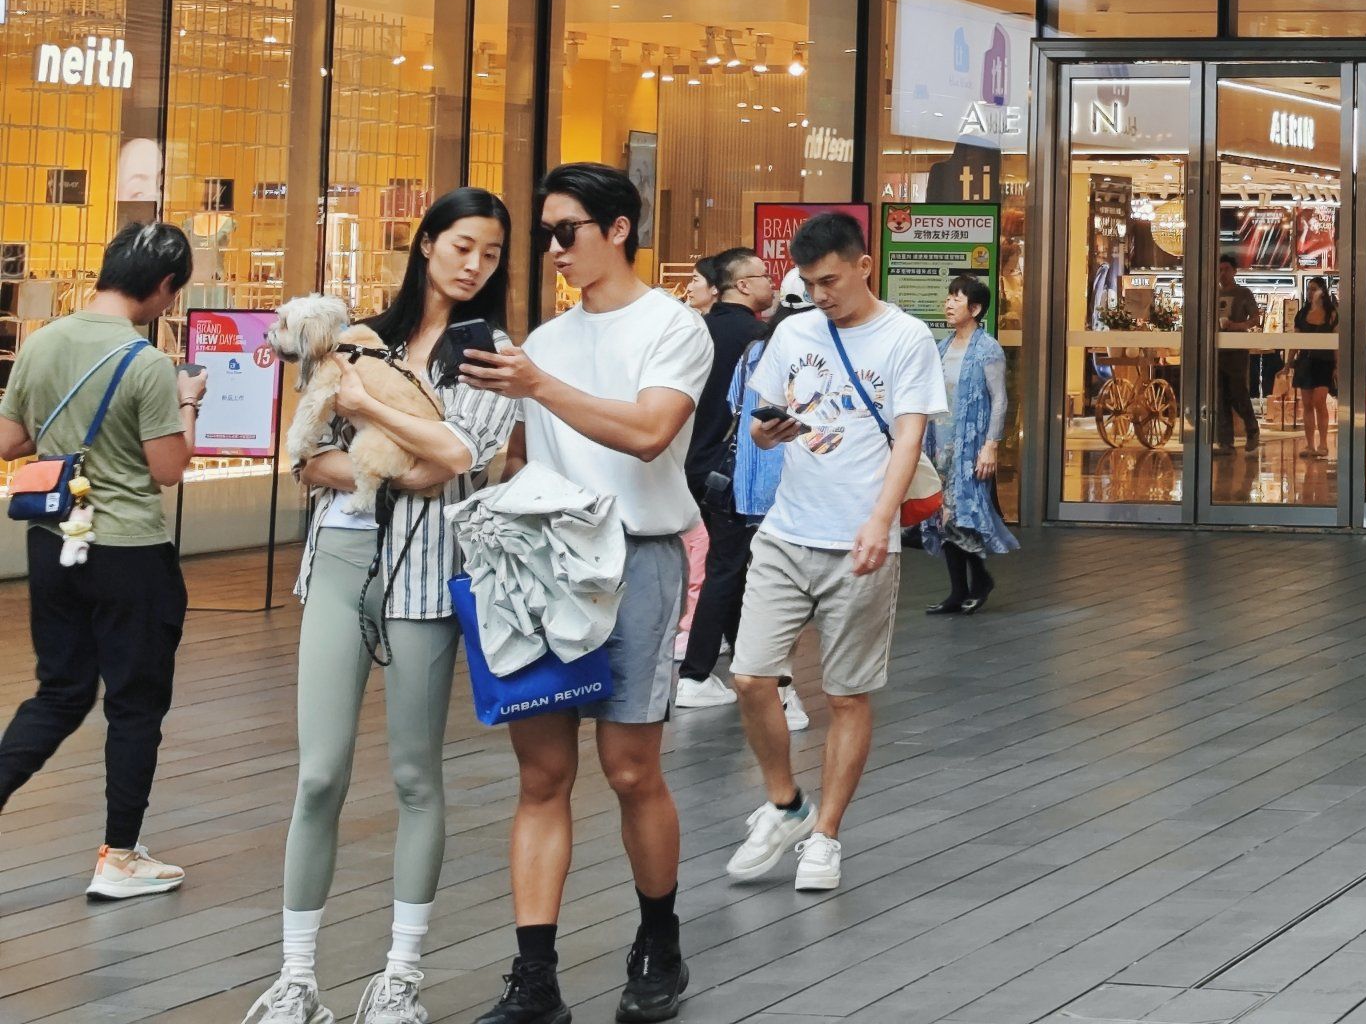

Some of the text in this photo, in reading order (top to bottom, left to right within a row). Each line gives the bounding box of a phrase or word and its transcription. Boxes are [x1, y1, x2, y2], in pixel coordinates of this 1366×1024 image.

[37, 35, 134, 89] neith
[763, 218, 809, 238] BRAN
[914, 218, 992, 228] PETS NOTICE
[913, 230, 969, 240] 宠物友好须知
[763, 239, 792, 259] NE
[196, 323, 222, 334] BRAND
[195, 333, 219, 345] NEW
[256, 347, 271, 365] 15
[790, 353, 830, 378] CARING
[500, 682, 602, 715] URBAN REVIVO
